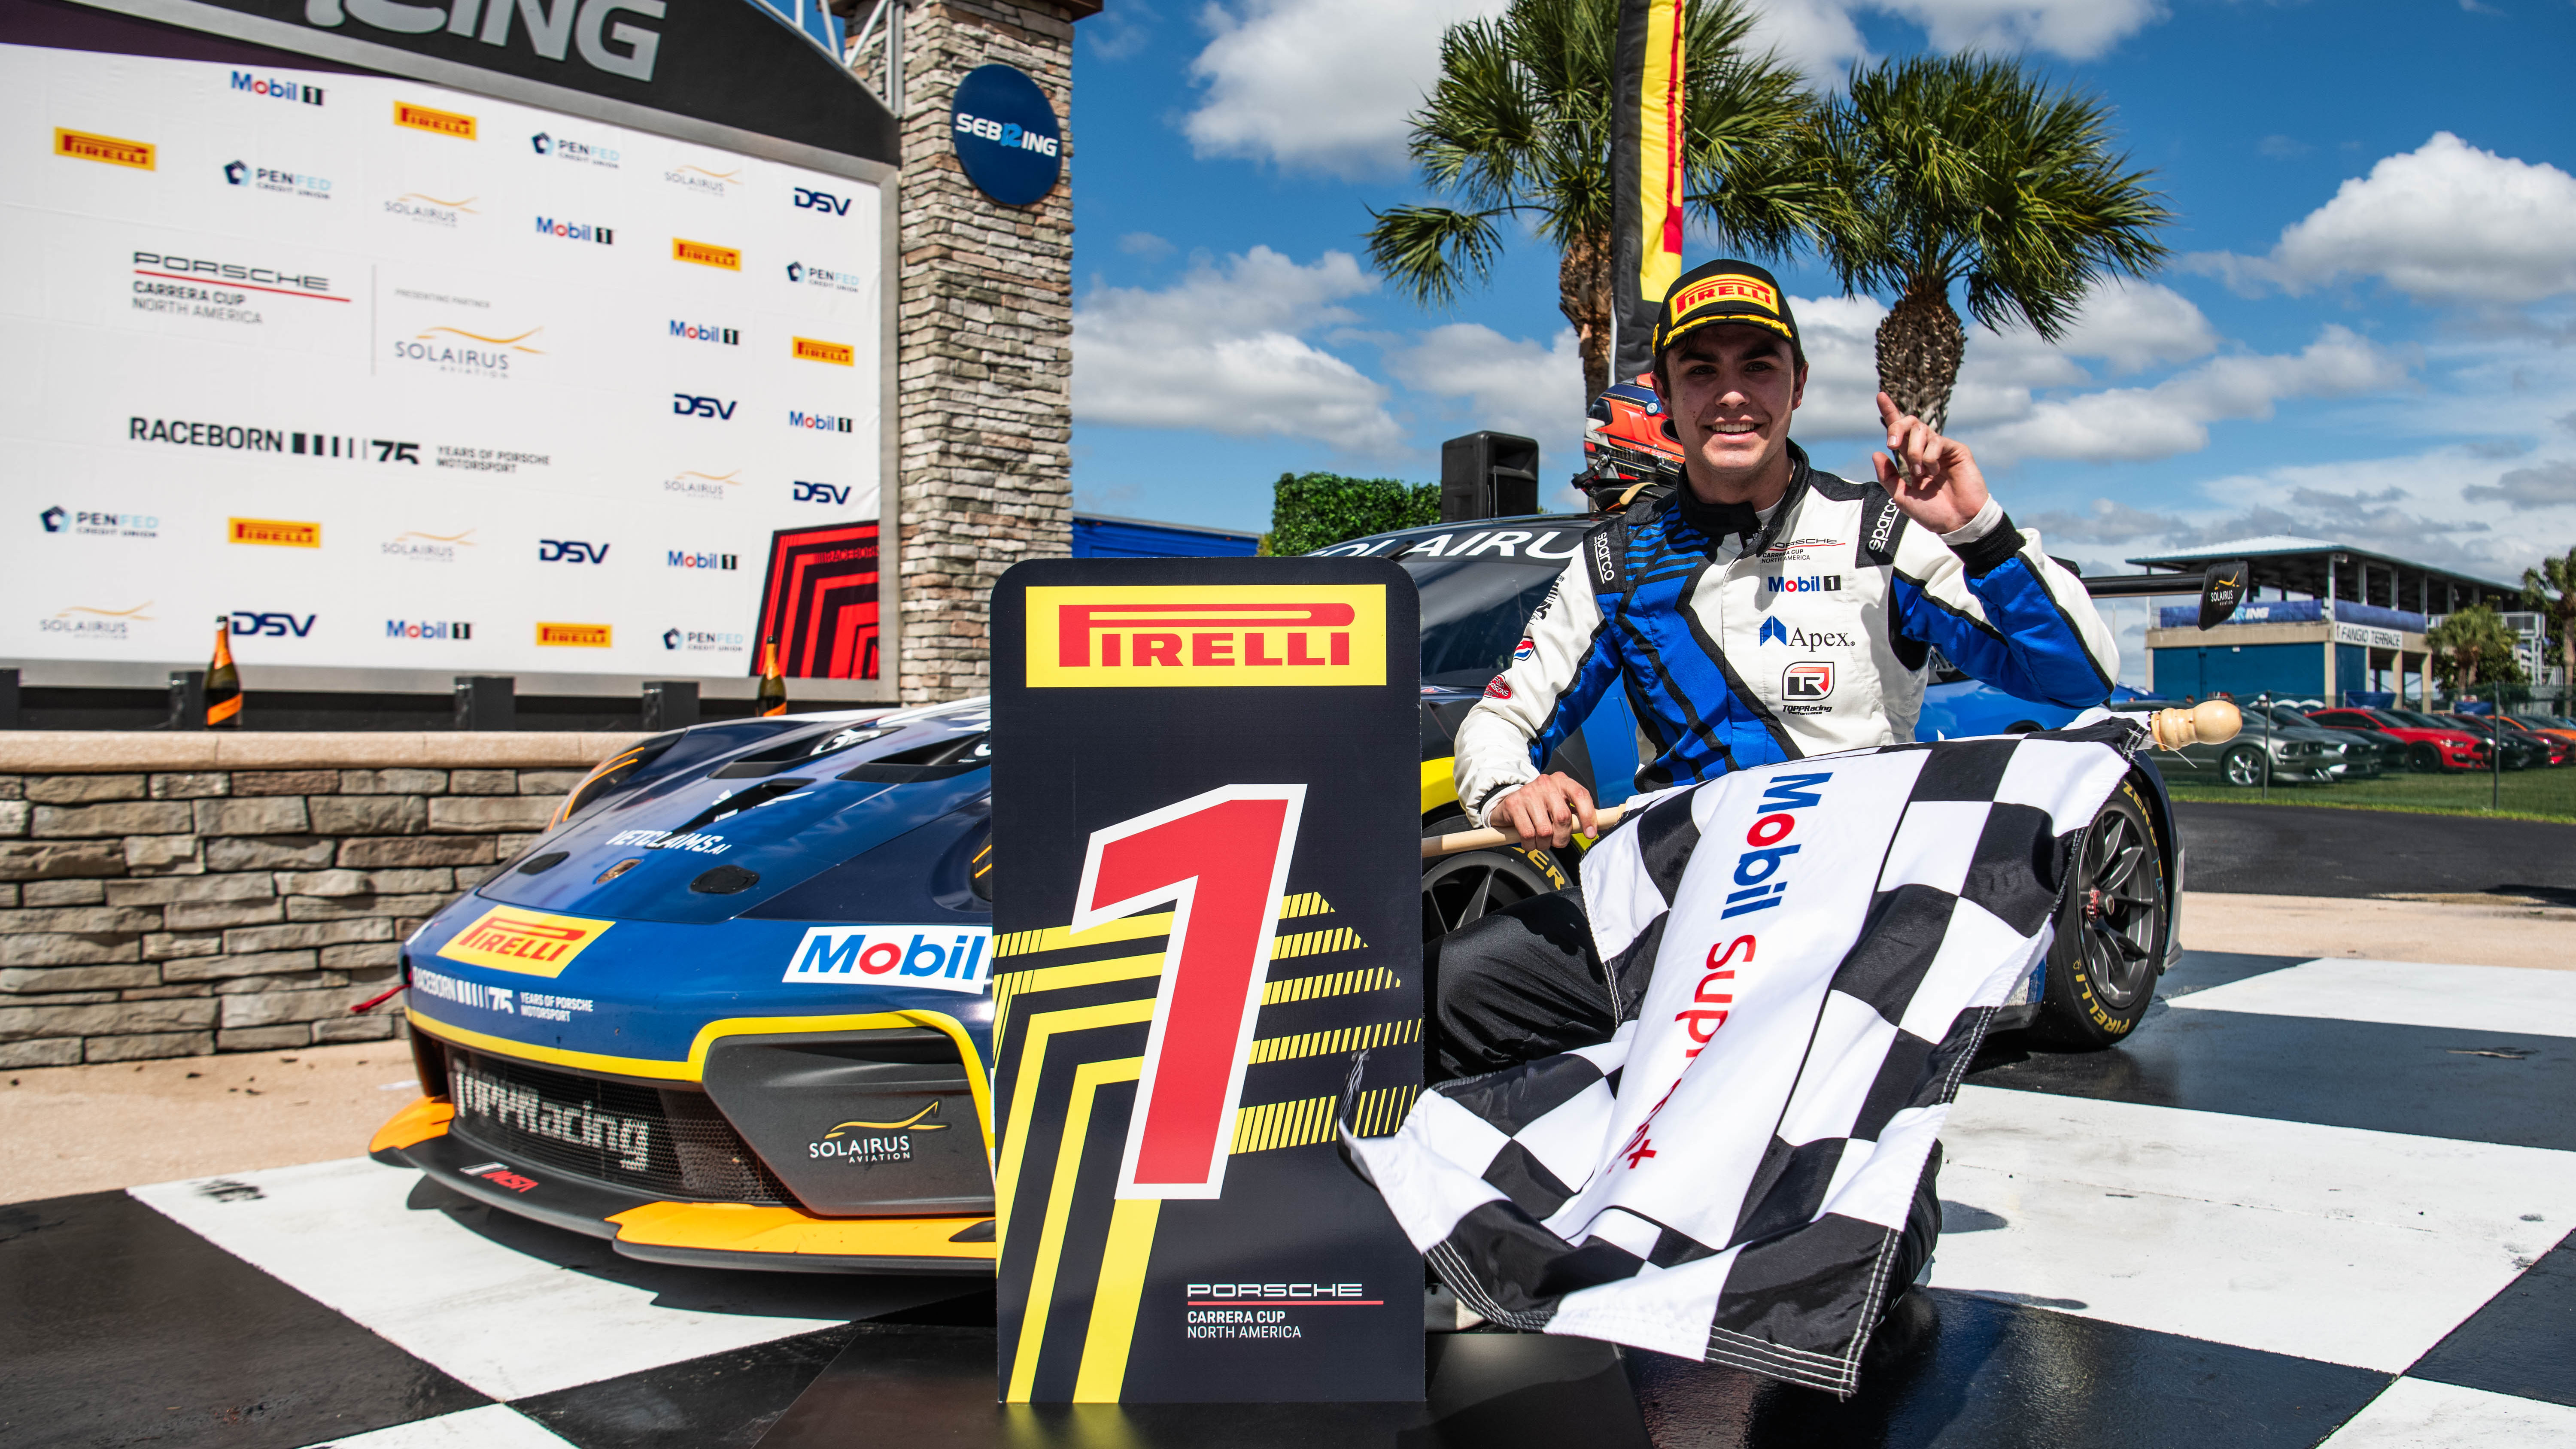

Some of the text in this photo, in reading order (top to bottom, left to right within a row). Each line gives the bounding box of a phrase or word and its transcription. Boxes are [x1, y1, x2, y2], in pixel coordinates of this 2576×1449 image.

[231, 71, 297, 100] Mobil
[400, 106, 471, 135] PIRELLI
[956, 113, 1058, 157] SEBRING
[62, 134, 149, 165] PIRELLI
[559, 140, 620, 161] PENFED
[257, 167, 331, 191] PENFED
[664, 170, 725, 192] SOLAIRUS
[384, 199, 458, 223] SOLAIRUS
[795, 188, 851, 216] DSV
[537, 216, 591, 241] Mobil
[678, 243, 736, 267] PIRELLI
[134, 252, 329, 291] PORSCHE
[809, 267, 859, 286] PENFED
[133, 281, 245, 306] CARRERA CUP
[1676, 279, 1771, 315] PIRELLI
[133, 297, 263, 325] NORTH AMERICA
[670, 320, 719, 342] Mobil
[394, 340, 509, 370] SOLAIRUS
[797, 340, 850, 362] PIRELLI
[674, 394, 737, 420] DSV
[790, 411, 834, 431] Mobil
[130, 417, 419, 465] RACEBORN 75
[663, 480, 724, 495] SOLAIRUS
[794, 481, 851, 505] DSV
[77, 512, 158, 529] PENFED
[236, 522, 314, 543] PIRELLI
[1771, 538, 1837, 548] ORSCHE
[381, 542, 455, 557] SOLAIRUS
[540, 540, 610, 564] DSV
[668, 550, 717, 568] Mobil
[1594, 532, 1615, 584] sparco
[1768, 576, 1820, 592] Mobil
[2211, 589, 2233, 602] SOLAIRUS
[39, 619, 129, 634] SOLAIRUS
[232, 611, 316, 637] DSV
[387, 620, 447, 639] Mobil
[542, 626, 606, 644] PIRELLI
[1059, 603, 1355, 667] PIRELLI
[688, 632, 743, 644] PENFED
[2342, 626, 2369, 643] FANGIO
[2370, 630, 2401, 647] TERRACE
[1488, 680, 1509, 697] ASONS
[1783, 705, 1833, 713] TOPPRacing
[1721, 772, 1833, 920] Mobil
[459, 916, 587, 962] PIRELLI
[798, 934, 986, 980] Mobil
[489, 986, 515, 1014] 75
[520, 991, 593, 1012] YEARS OF PORSCHE
[1069, 784, 1308, 1200] 1
[520, 1005, 571, 1022] MOTORSPORT
[2075, 973, 2130, 1034] PIRELLI
[809, 1136, 910, 1158] SOLAIRUS
[848, 1152, 910, 1163] AVIATION
[1187, 1283, 1363, 1297] PORSCHE
[1188, 1311, 1285, 1323] CARRERA CUP
[1188, 1326, 1302, 1338] NORTH AMERICA
